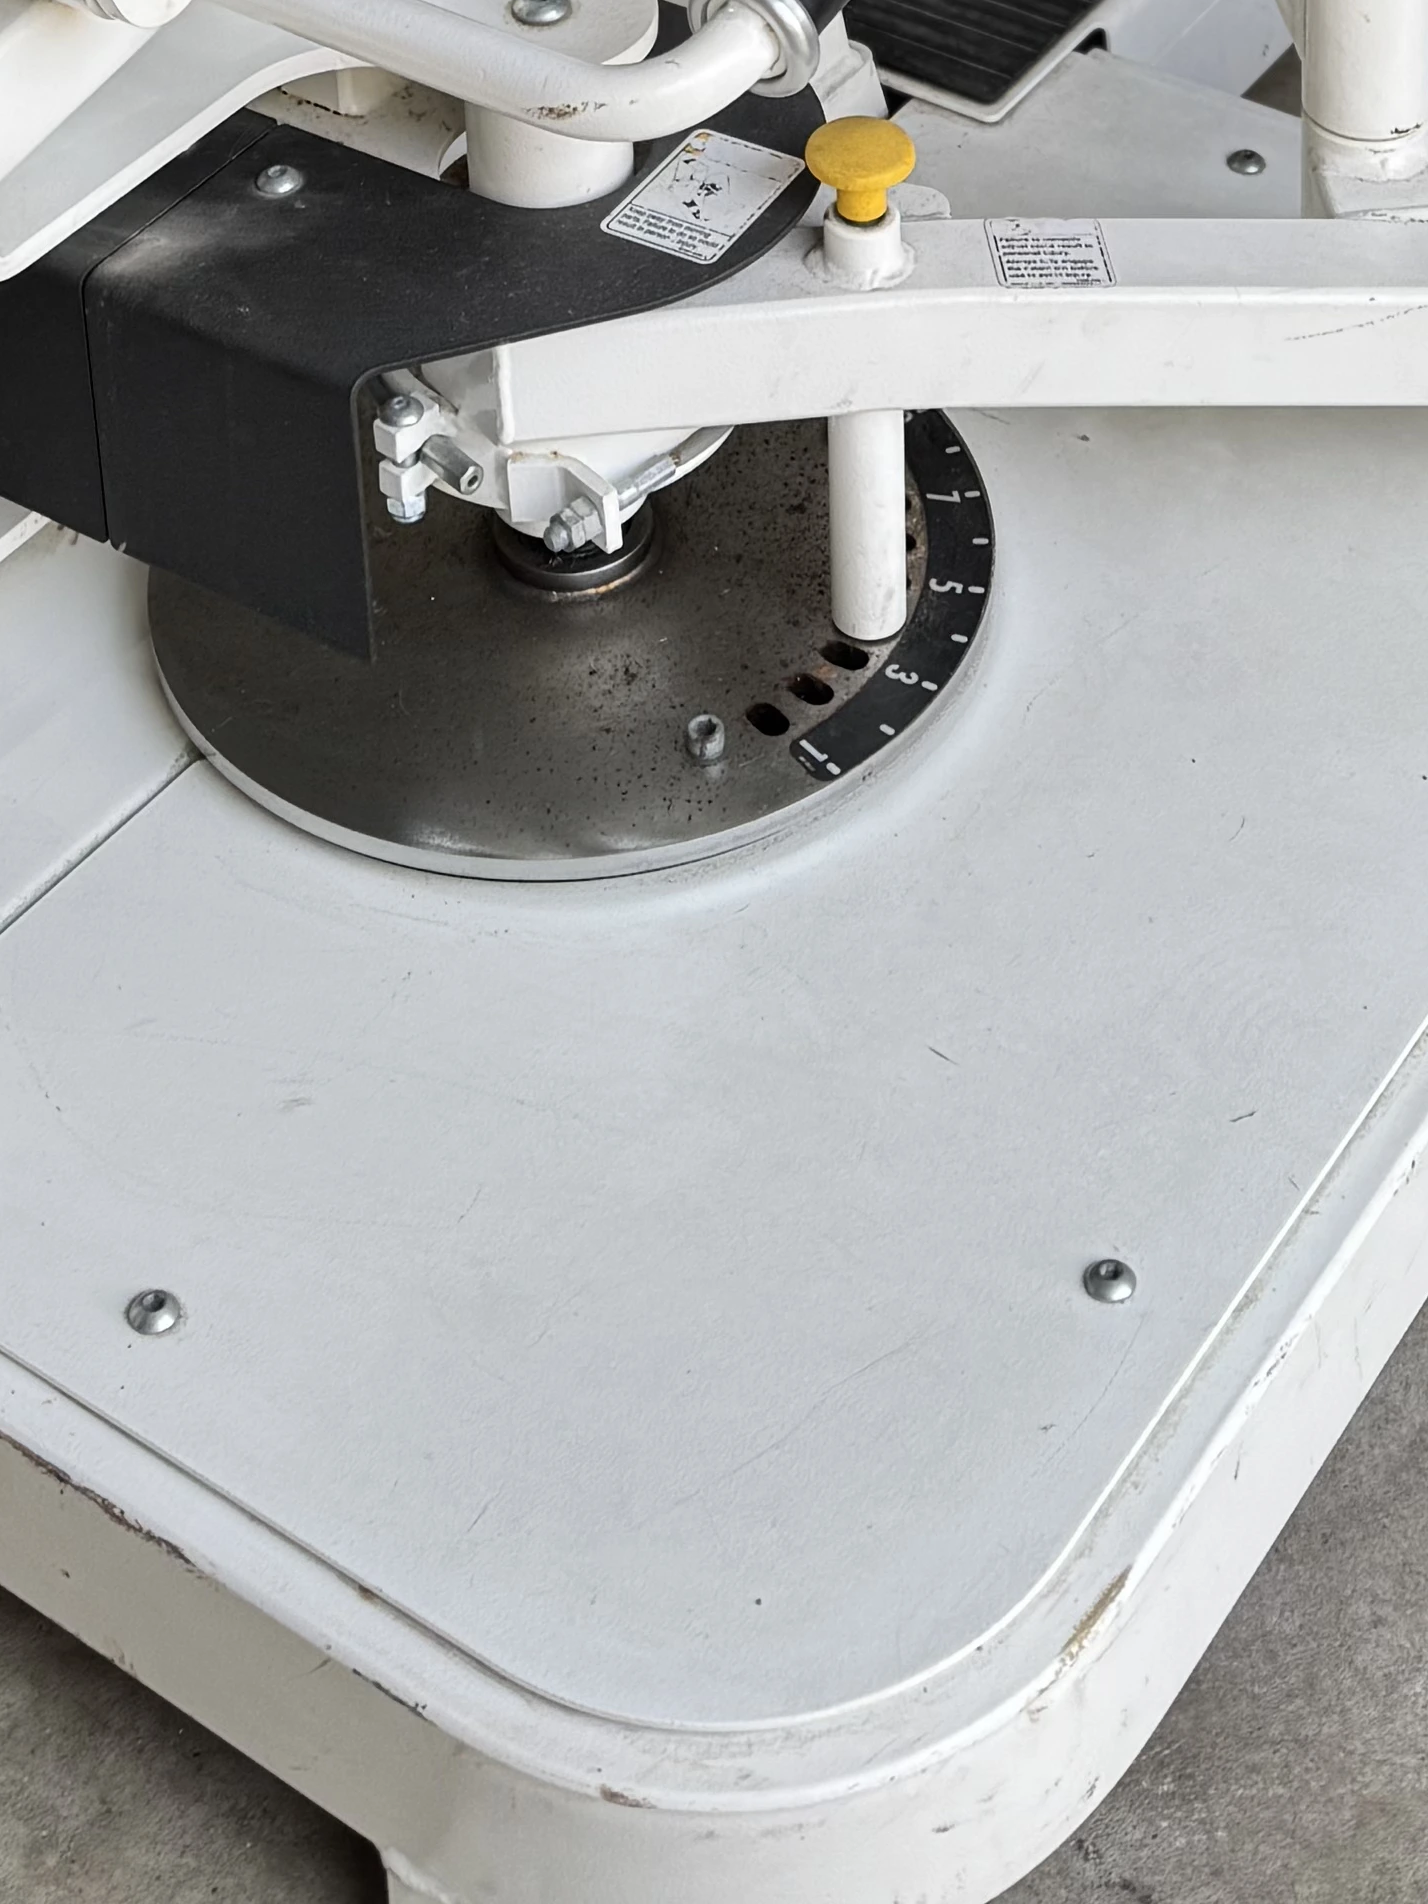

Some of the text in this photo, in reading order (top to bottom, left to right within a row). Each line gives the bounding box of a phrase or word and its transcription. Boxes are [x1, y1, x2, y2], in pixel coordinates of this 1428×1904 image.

[925, 489, 962, 505] 7
[928, 577, 964, 595] 5
[884, 663, 920, 686] 3
[798, 738, 830, 764] 1
